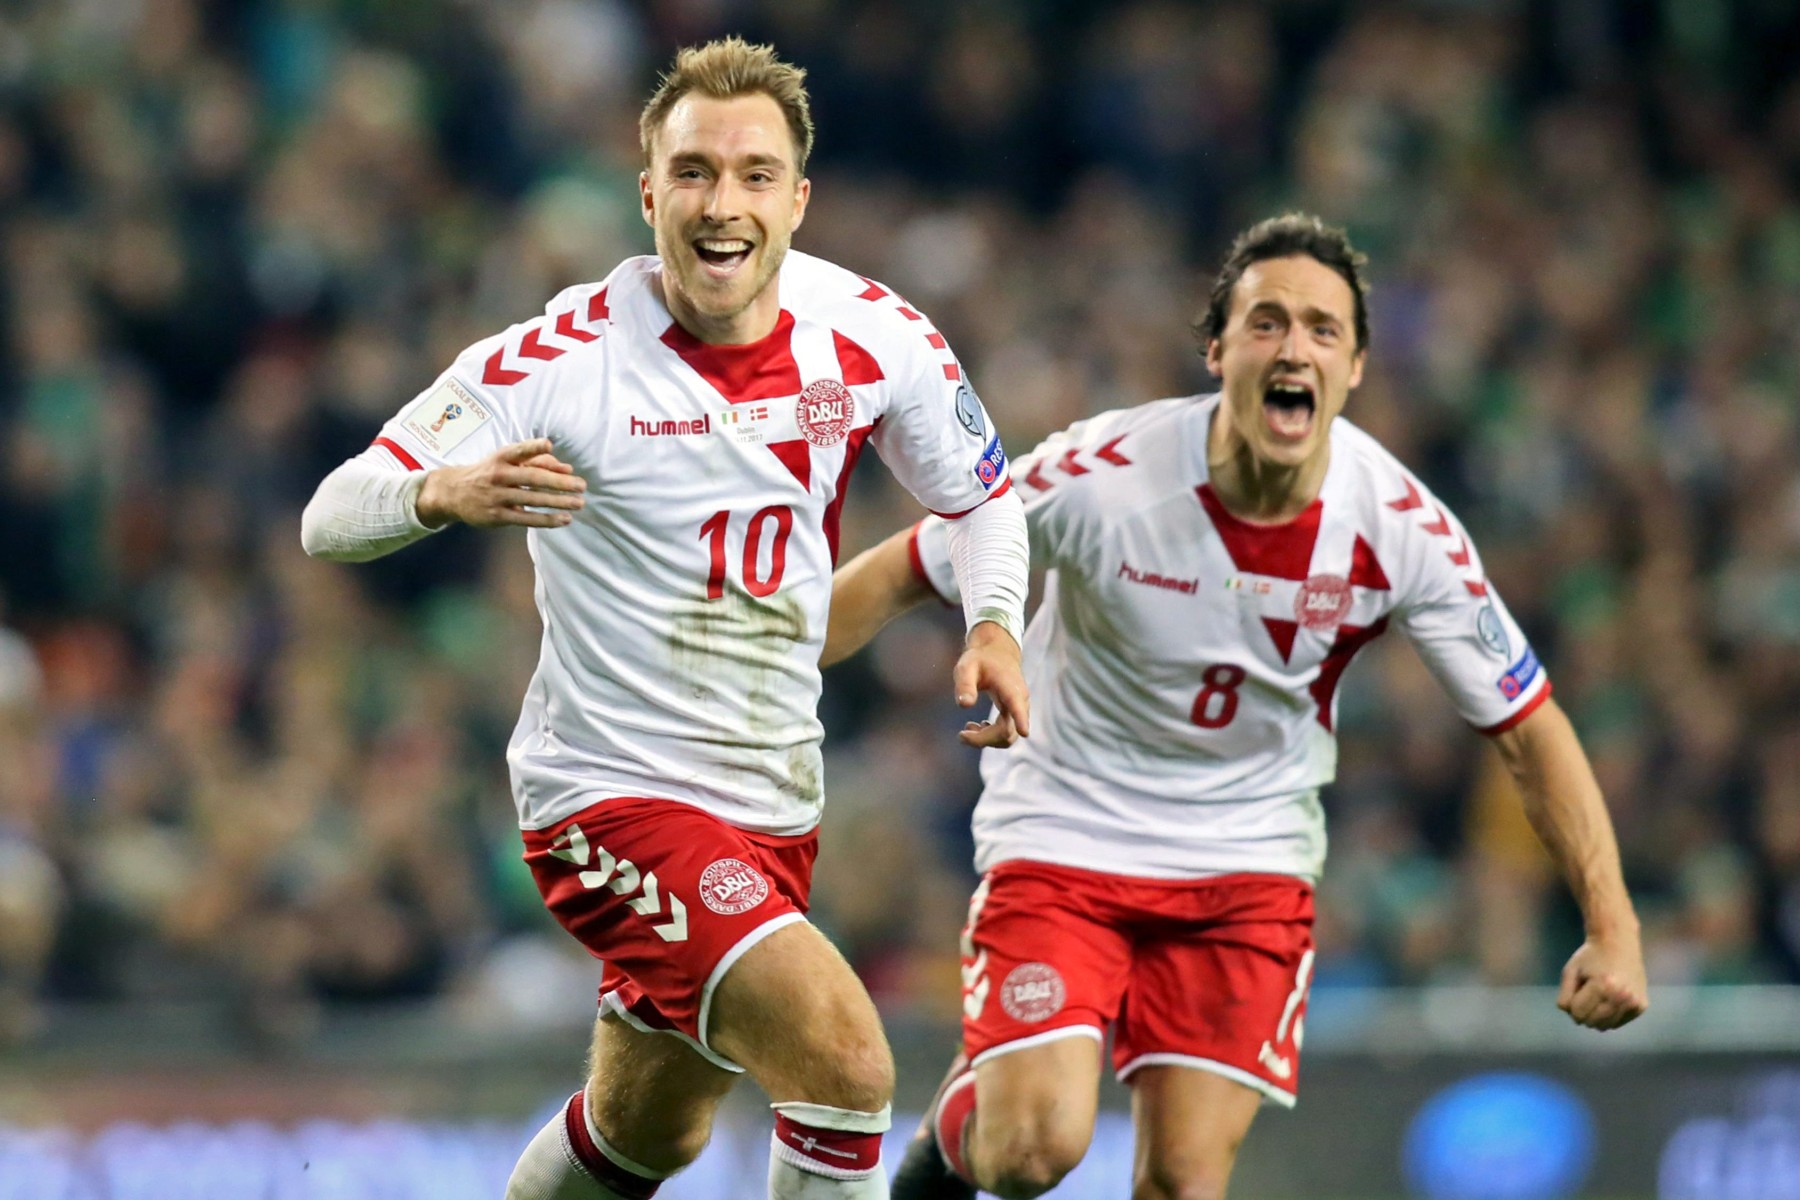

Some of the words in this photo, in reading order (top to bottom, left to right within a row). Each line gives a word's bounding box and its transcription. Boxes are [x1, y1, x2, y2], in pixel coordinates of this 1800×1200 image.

[630, 413, 710, 436] hummel
[808, 400, 844, 424] DBU
[816, 433, 841, 446] 1889
[699, 504, 793, 599] 10
[1118, 560, 1198, 595] hummel
[1190, 663, 1248, 729] 8
[712, 871, 755, 901] DBU
